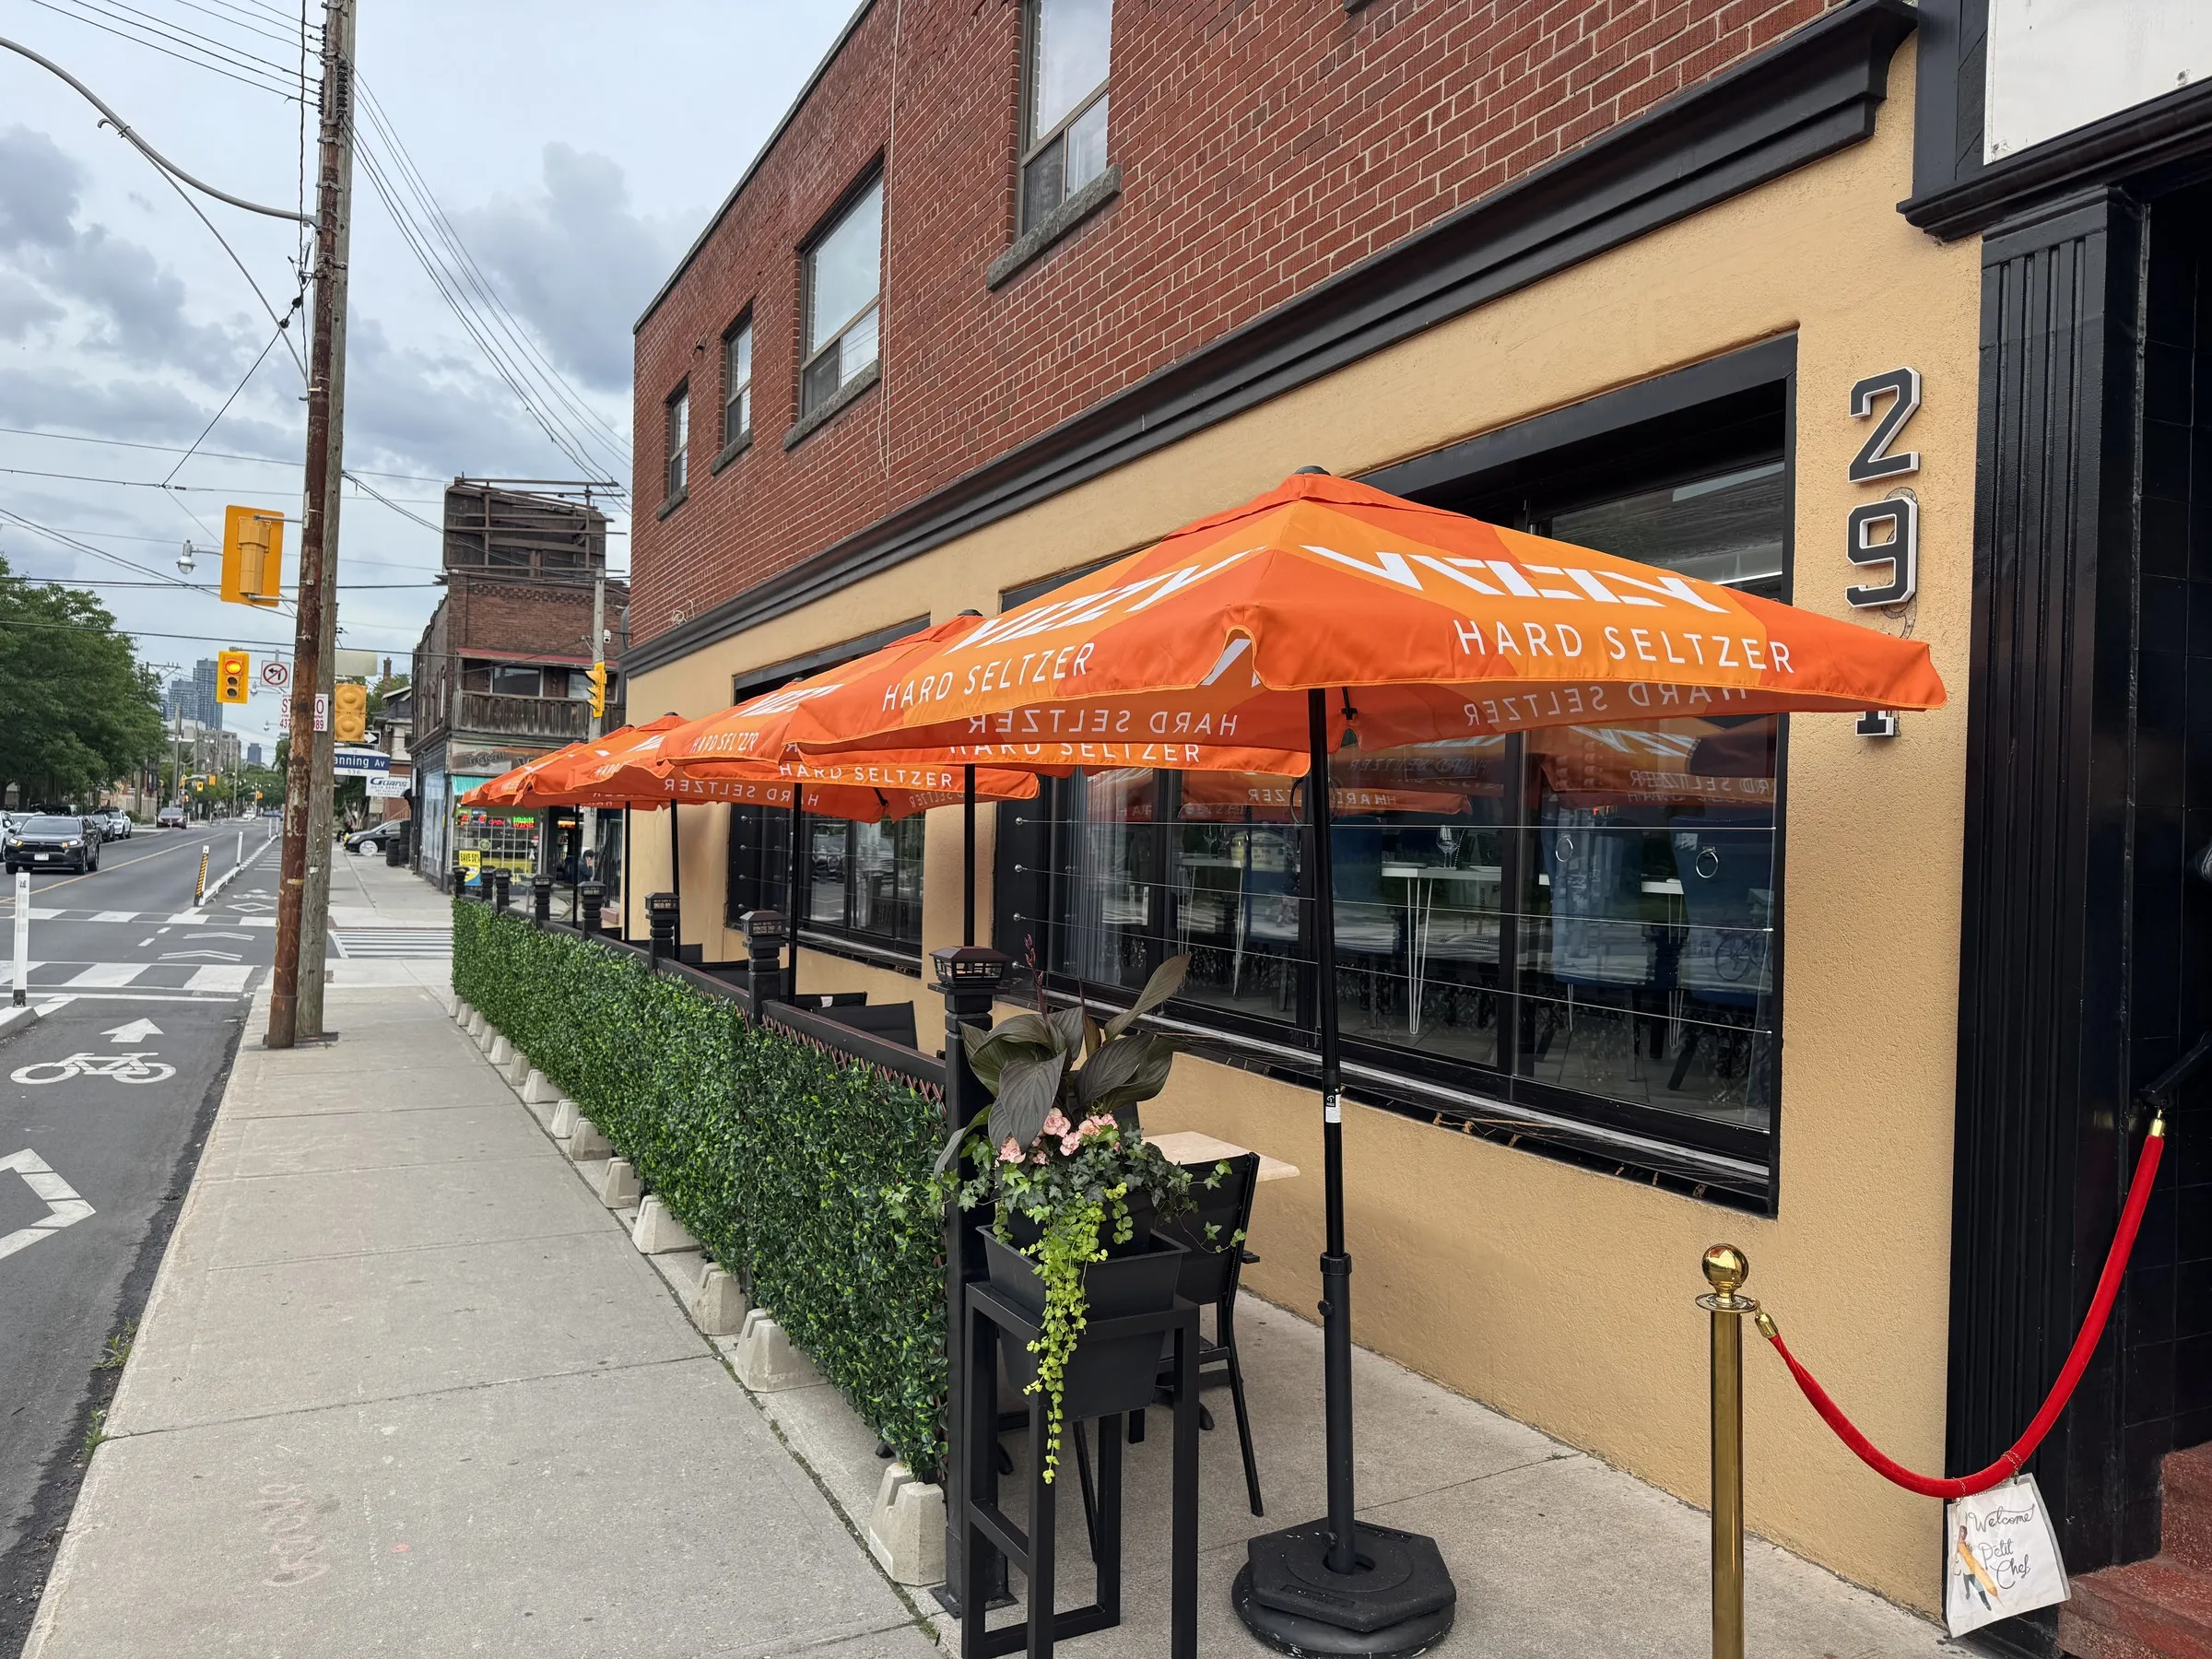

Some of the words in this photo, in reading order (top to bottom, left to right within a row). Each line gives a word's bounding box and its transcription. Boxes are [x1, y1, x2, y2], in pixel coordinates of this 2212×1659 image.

[1845, 366, 1921, 739] 29
[1453, 618, 1583, 658] HARD
[1604, 626, 1794, 674] SELTZER
[882, 671, 953, 712] HARD
[964, 642, 1095, 695] SELTZER
[334, 756, 369, 768] anning
[374, 759, 385, 768] Av
[854, 767, 953, 788] SELTZER
[460, 853, 471, 863] SAVE
[1969, 1503, 2035, 1533] Welcome
[1989, 1554, 2031, 1590] Chef
